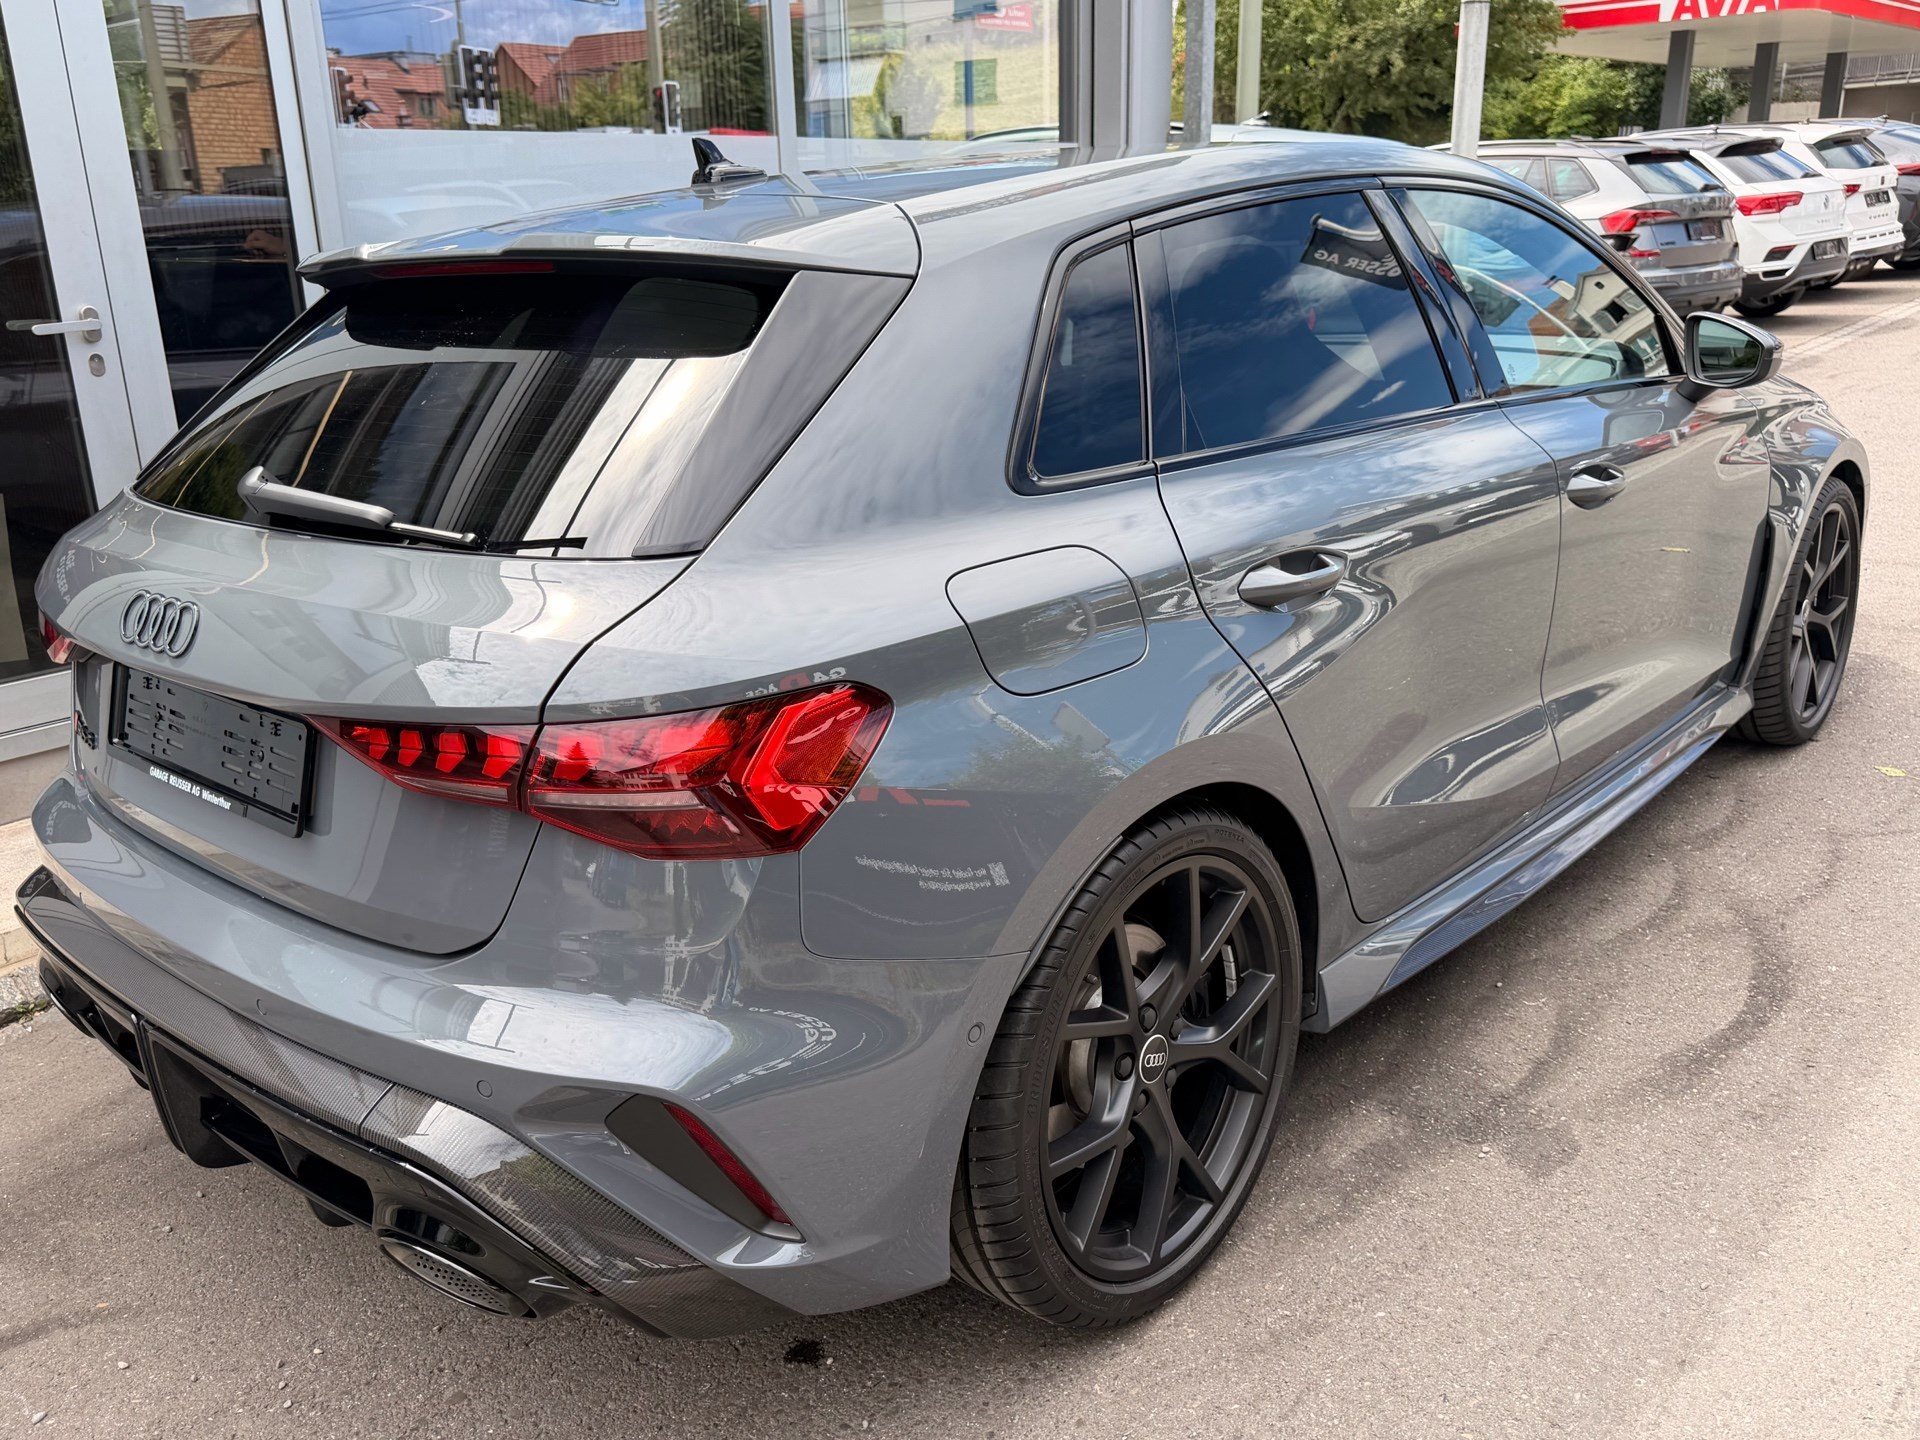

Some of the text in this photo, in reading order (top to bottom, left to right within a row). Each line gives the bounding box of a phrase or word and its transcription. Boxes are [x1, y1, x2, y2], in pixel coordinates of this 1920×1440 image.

[149, 766, 232, 810] GARAGE REUSSER AG Winterthur
